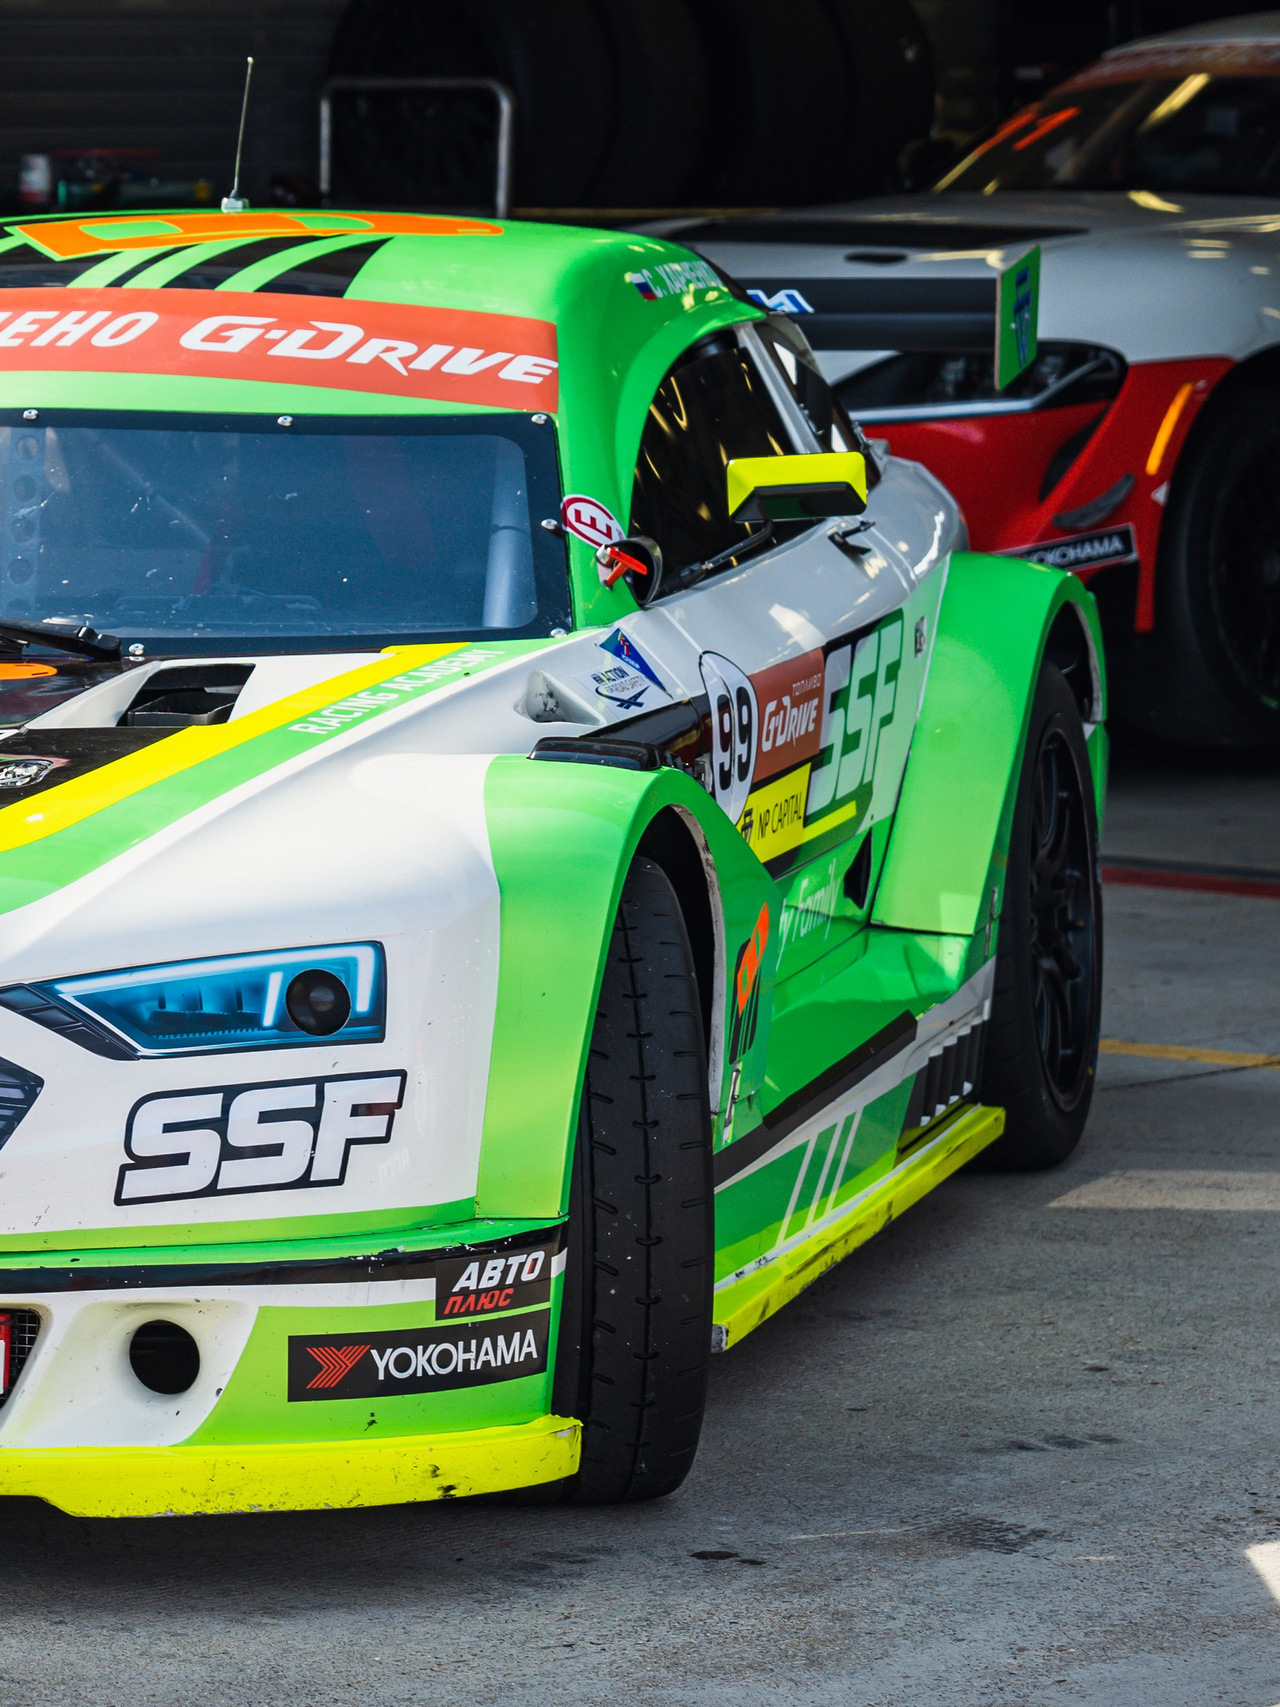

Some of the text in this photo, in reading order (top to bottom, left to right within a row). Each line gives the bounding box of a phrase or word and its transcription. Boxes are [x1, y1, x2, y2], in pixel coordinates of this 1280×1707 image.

[287, 648, 505, 735] RACING ACADEMY
[804, 618, 903, 817] SSF
[717, 686, 752, 791] 99
[757, 790, 803, 841] NP CAPITAL
[114, 1069, 407, 1206] SSF
[443, 1288, 515, 1315] ПЛЮС
[451, 1250, 545, 1293] АВТО
[370, 1329, 538, 1380] YOKOHAMA
